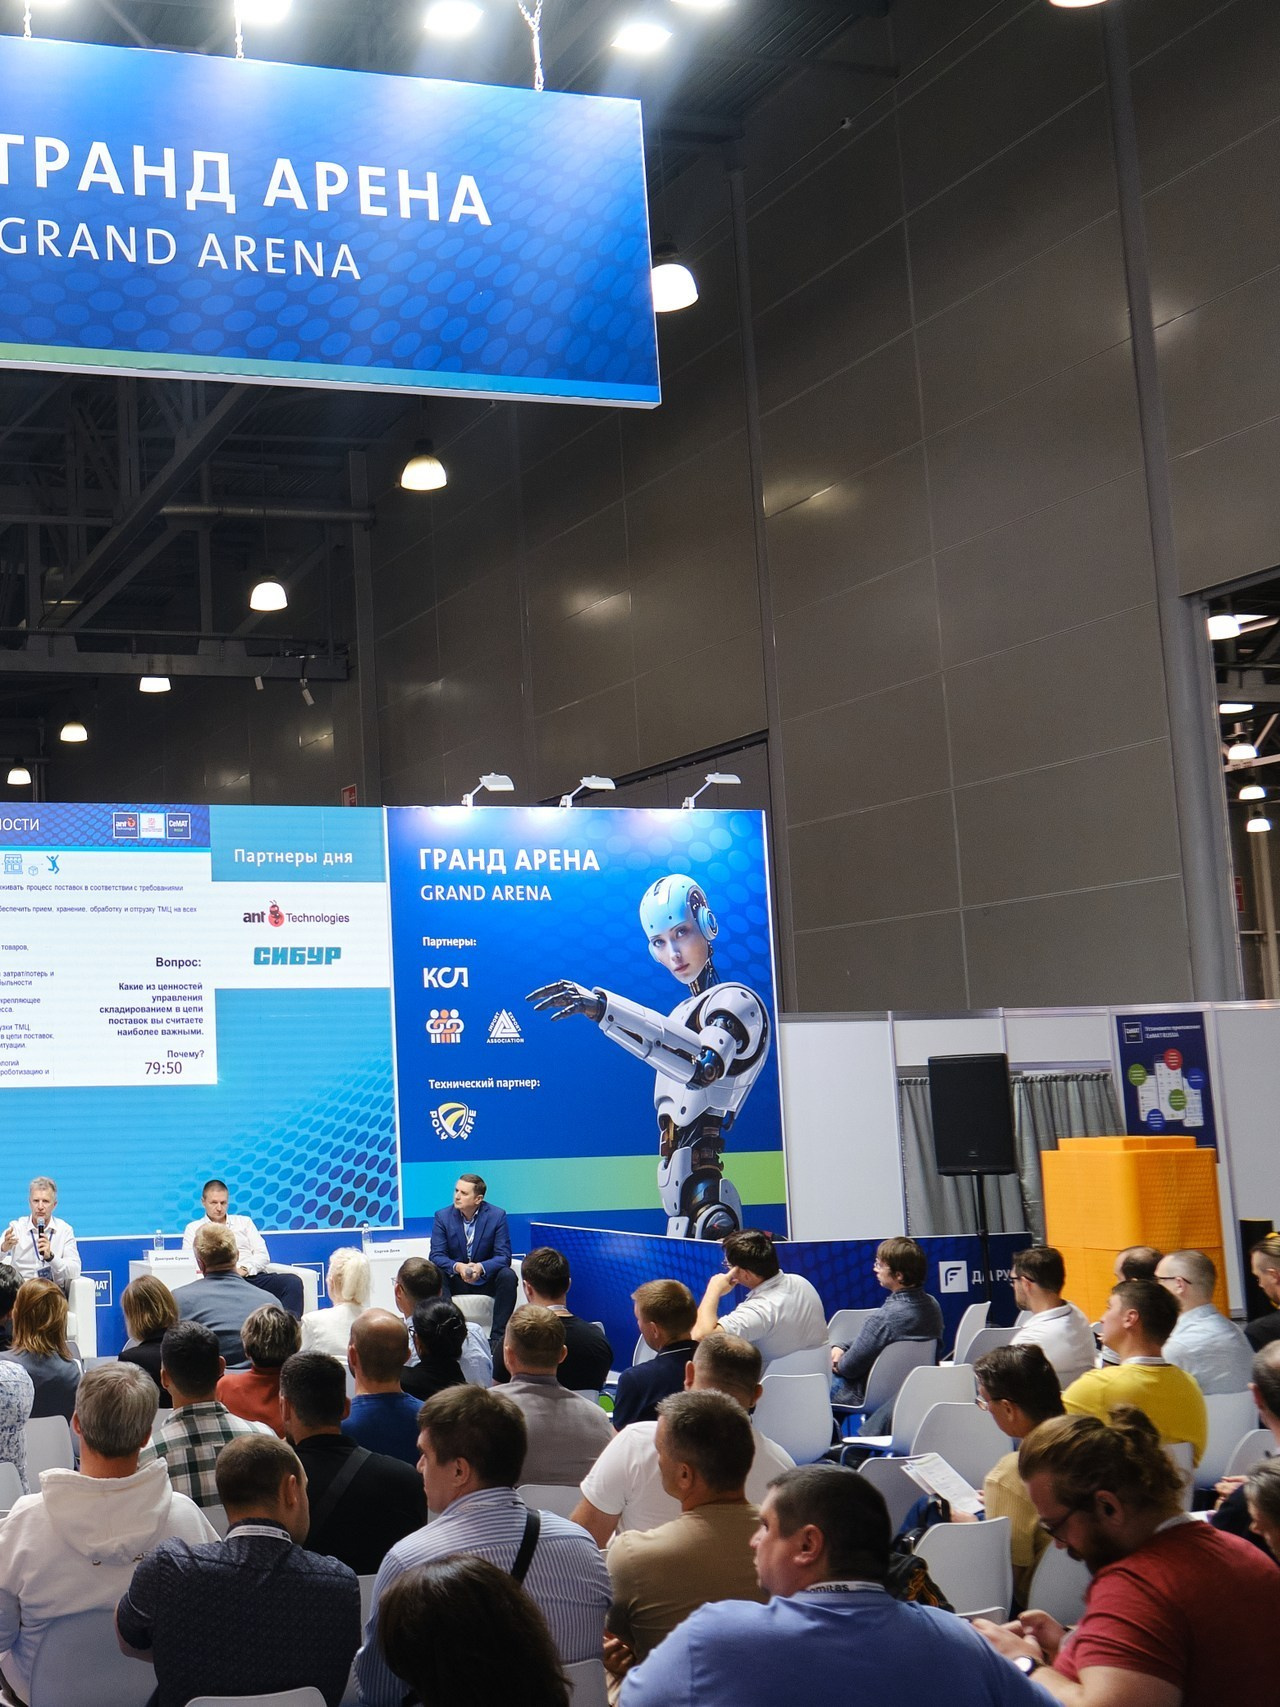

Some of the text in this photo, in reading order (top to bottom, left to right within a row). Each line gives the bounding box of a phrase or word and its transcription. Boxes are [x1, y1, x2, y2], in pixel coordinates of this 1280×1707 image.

[263, 156, 492, 226] АРЕНА
[197, 232, 362, 280] ARENA
[234, 848, 353, 867] Партнеры дня
[419, 848, 600, 875] ГРАНД АРЕНА
[420, 884, 552, 902] GRAND ARENA
[242, 911, 350, 925] ant Technologies
[422, 936, 477, 949] Партнеры:
[155, 957, 202, 969] Вопрос:
[253, 946, 342, 966] СИБУР
[423, 966, 469, 989] КСЛ
[118, 982, 144, 991] Какие
[158, 982, 203, 992] ценностей
[151, 995, 203, 1003] управления
[99, 1006, 173, 1015] складированием
[182, 1006, 204, 1014] цепи
[108, 1017, 148, 1025] поставок
[117, 1027, 204, 1036] наиболее важными.
[167, 1049, 205, 1060] Почему?
[144, 1061, 183, 1075] 79:50
[428, 1078, 541, 1091] Технический партнер:
[429, 1110, 449, 1141] POLY
[460, 1109, 477, 1141] SAFE
